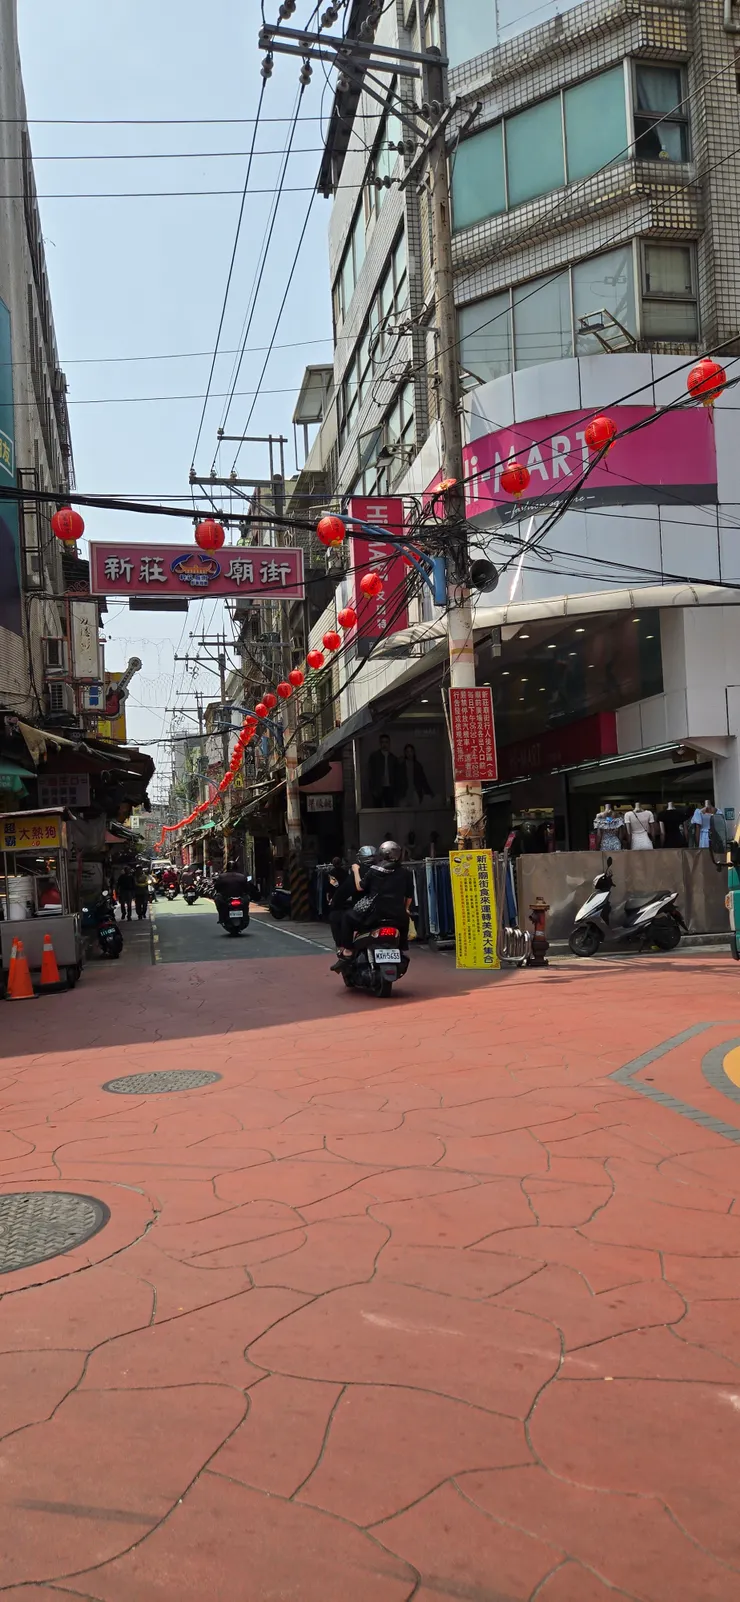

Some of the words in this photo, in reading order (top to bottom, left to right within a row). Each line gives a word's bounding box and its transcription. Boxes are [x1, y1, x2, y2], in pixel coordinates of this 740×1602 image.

[104, 555, 168, 583] 新莊
[225, 557, 291, 586] 廟街
[19, 826, 56, 840] 大熱狗
[477, 855, 493, 964] 新莊廟街食來運轉美食大集合
